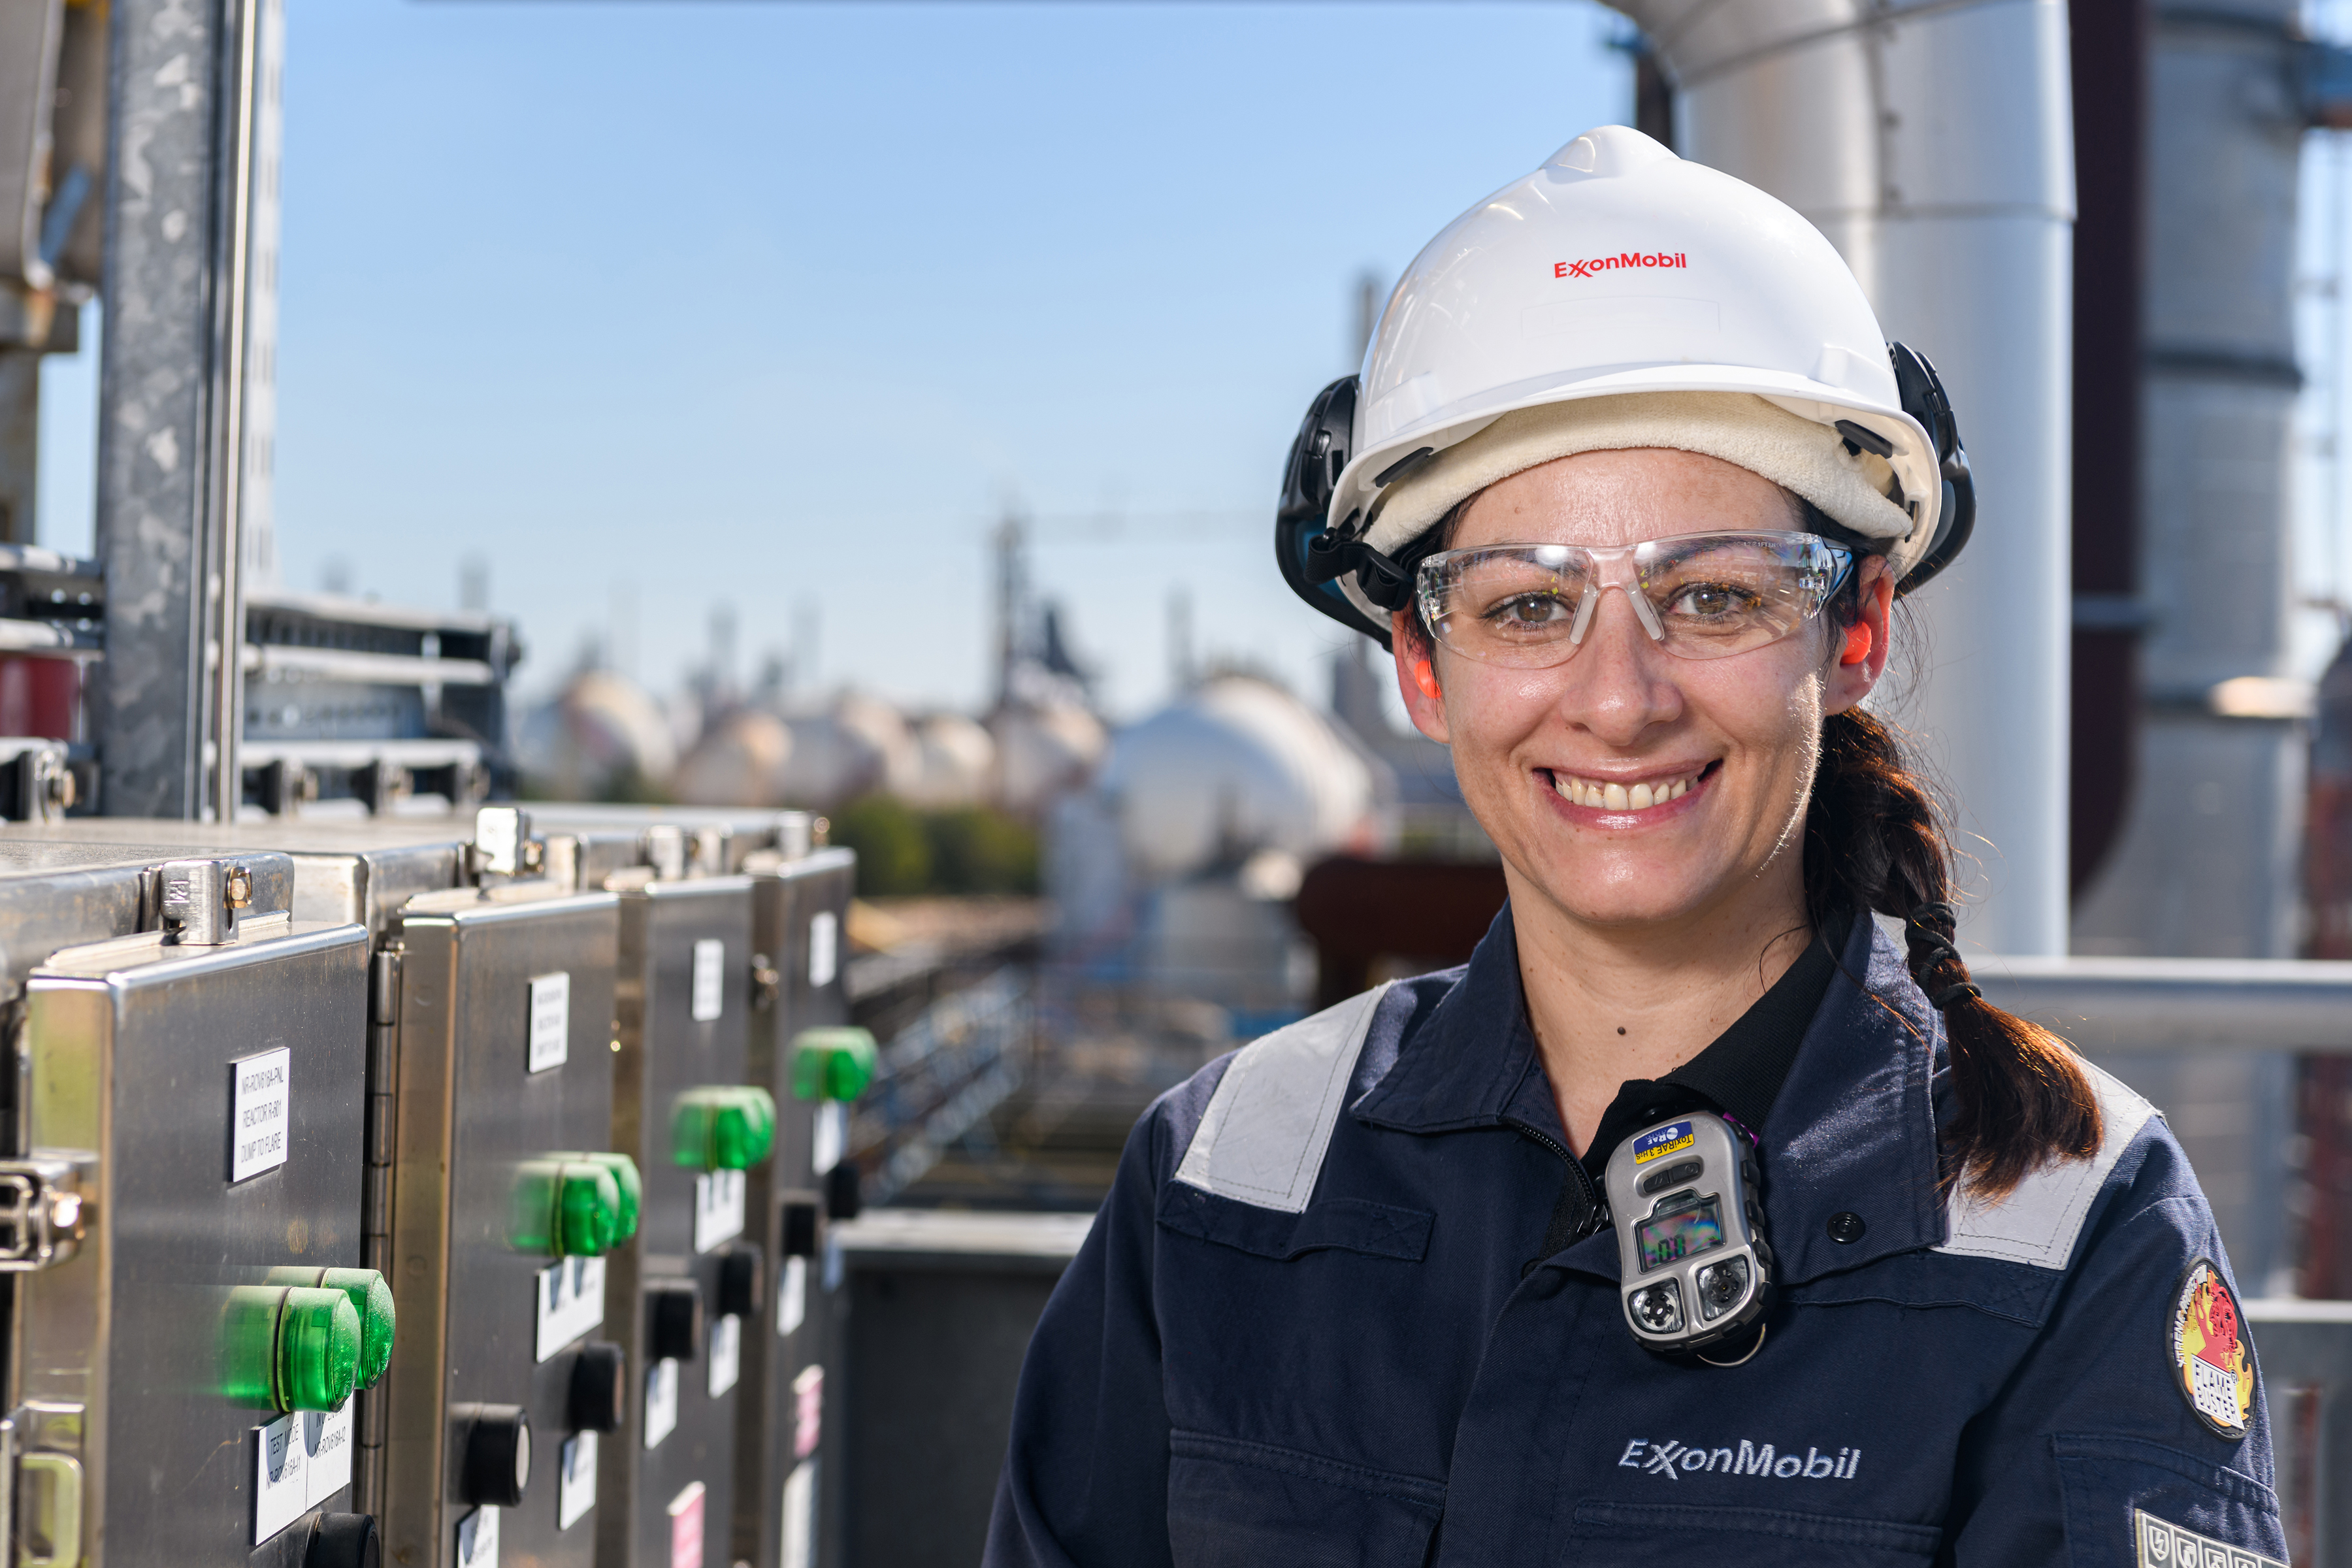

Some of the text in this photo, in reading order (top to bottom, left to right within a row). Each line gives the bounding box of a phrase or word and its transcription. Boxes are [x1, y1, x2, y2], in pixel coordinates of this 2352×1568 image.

[1554, 253, 1687, 278] ExxonMobil
[242, 1104, 267, 1128] REACTOR
[240, 1132, 282, 1163] DUMP TO FLARE
[1650, 1148, 1654, 1156] 3
[1656, 1134, 1691, 1155] ToxiRAE
[2195, 1364, 2231, 1401] FLAME
[2197, 1386, 2239, 1422] BUSTER
[270, 1424, 299, 1456] TEST MODE
[1618, 1438, 1861, 1480] ExxonMobil
